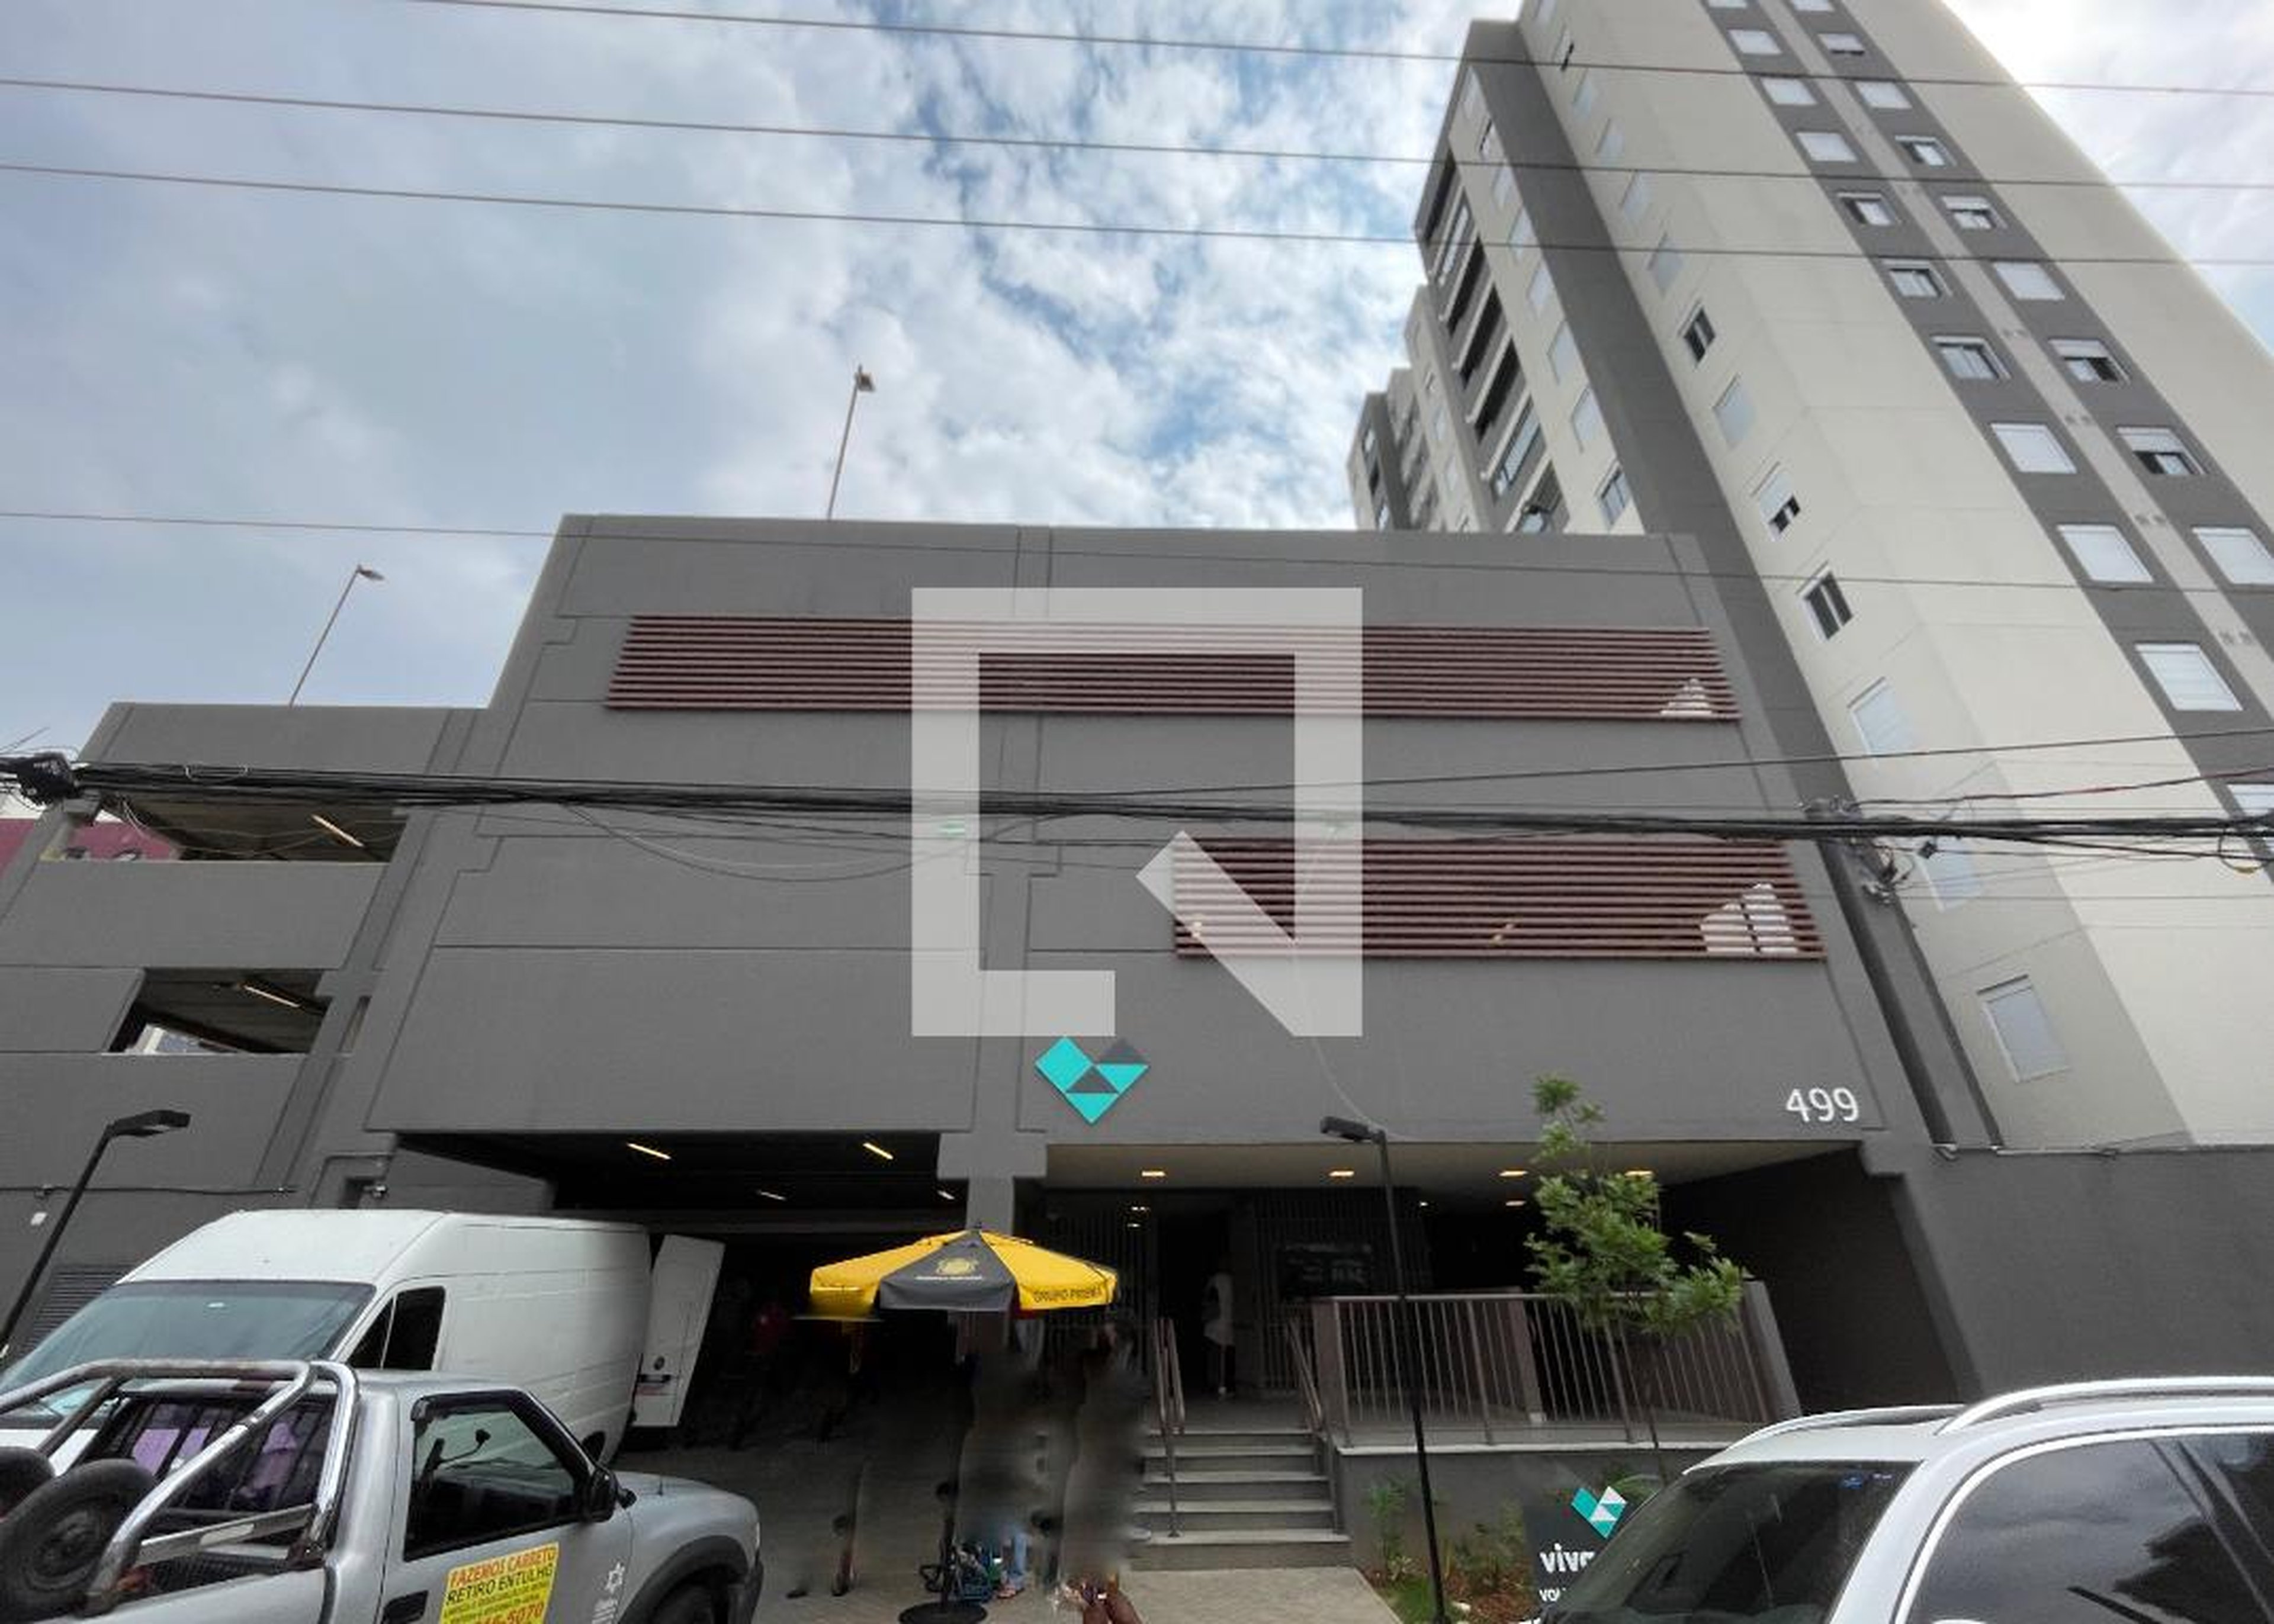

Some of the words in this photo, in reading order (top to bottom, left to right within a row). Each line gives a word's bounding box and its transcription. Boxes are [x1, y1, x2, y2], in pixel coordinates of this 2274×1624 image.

[1786, 1088, 1859, 1122] 499
[447, 1579, 495, 1605] RETIRO
[497, 1562, 553, 1591] ENTULHO
[450, 1559, 505, 1588] FAZEMOS
[507, 1546, 556, 1571] CARRETO
